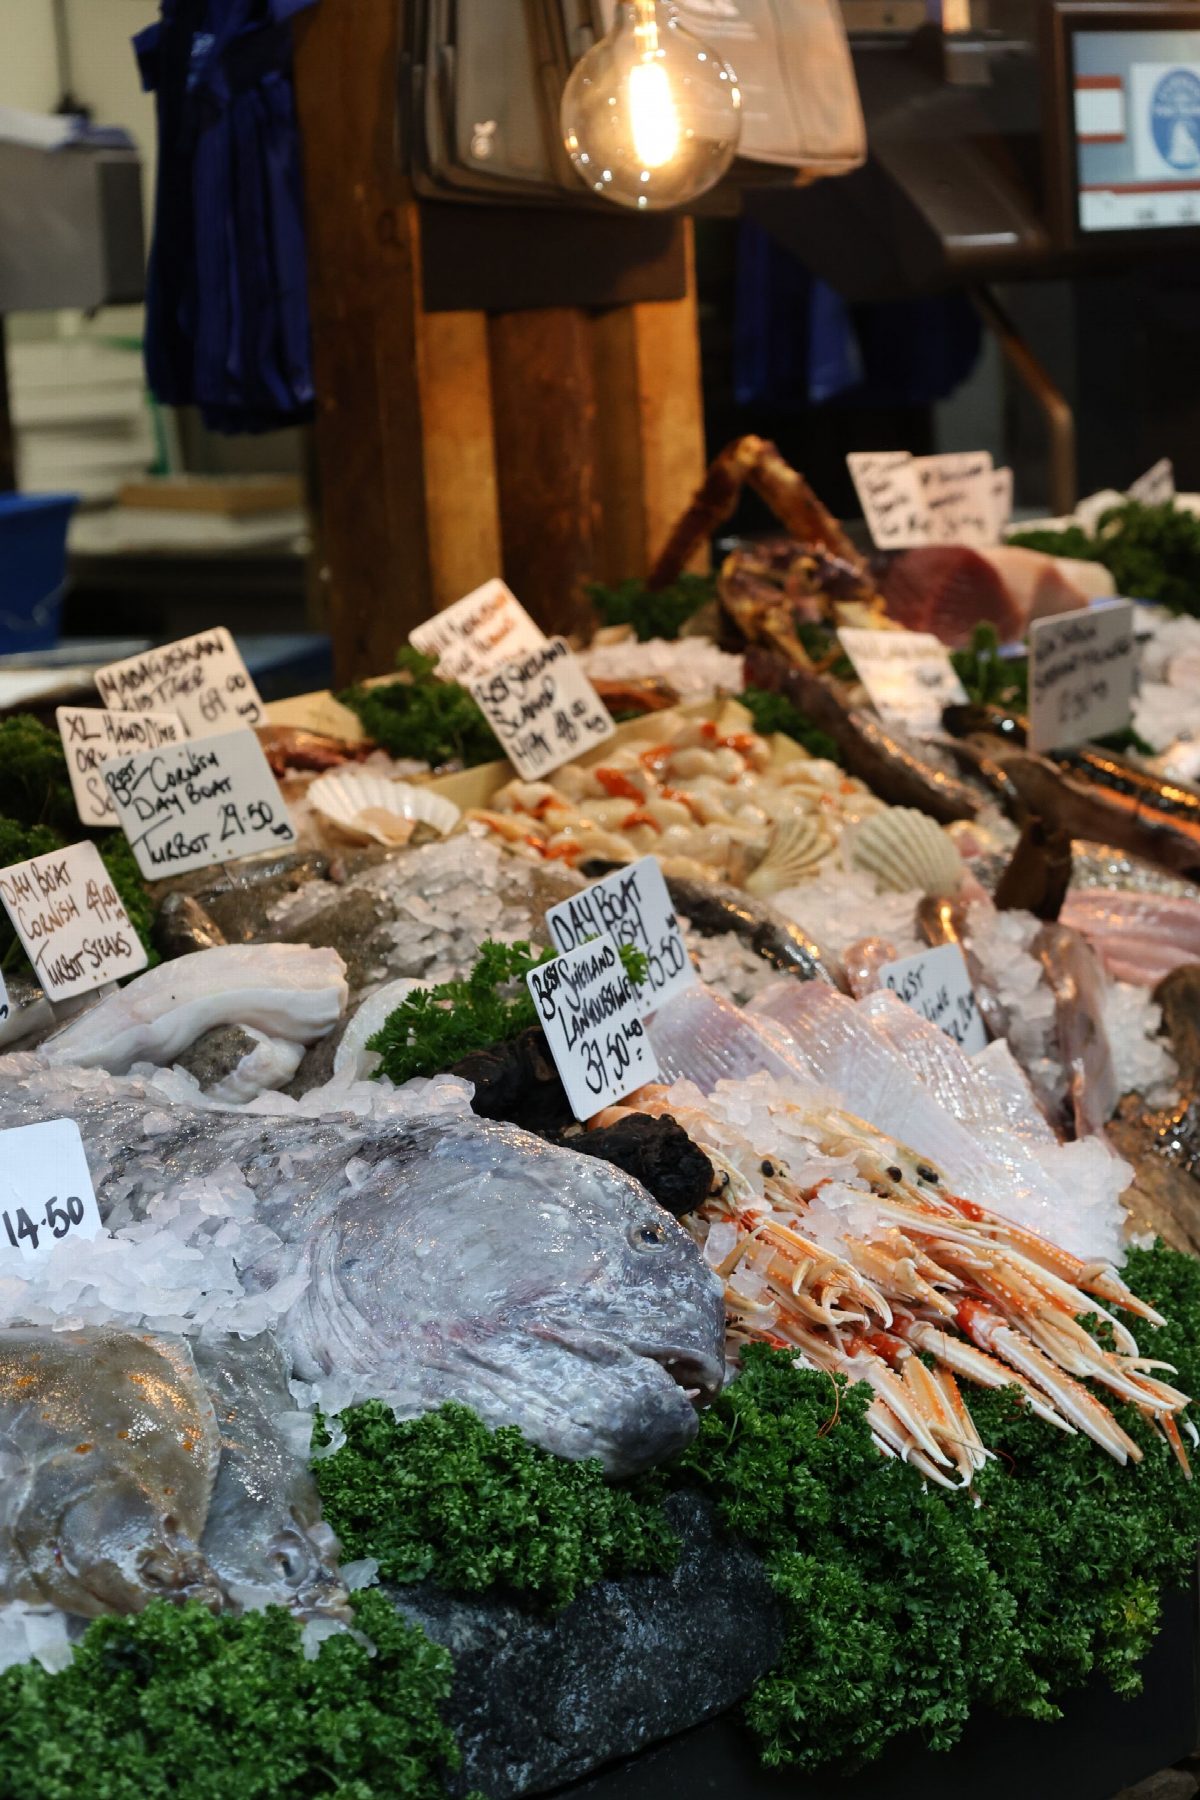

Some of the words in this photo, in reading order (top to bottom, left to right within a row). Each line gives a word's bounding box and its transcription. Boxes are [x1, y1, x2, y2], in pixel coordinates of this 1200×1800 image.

[65, 714, 101, 742] XL
[106, 759, 137, 808] BEST
[132, 796, 186, 822] DAY
[186, 777, 233, 804] BOAT
[131, 815, 211, 865] TURBOT
[552, 896, 603, 952] DAY
[592, 871, 641, 931] BOAT
[35, 939, 86, 987] TURBOT
[82, 931, 133, 968] STEAKS
[532, 961, 562, 1021] BEST
[558, 946, 615, 1012] SHETLAND
[1, 1196, 85, 1249] 14.50
